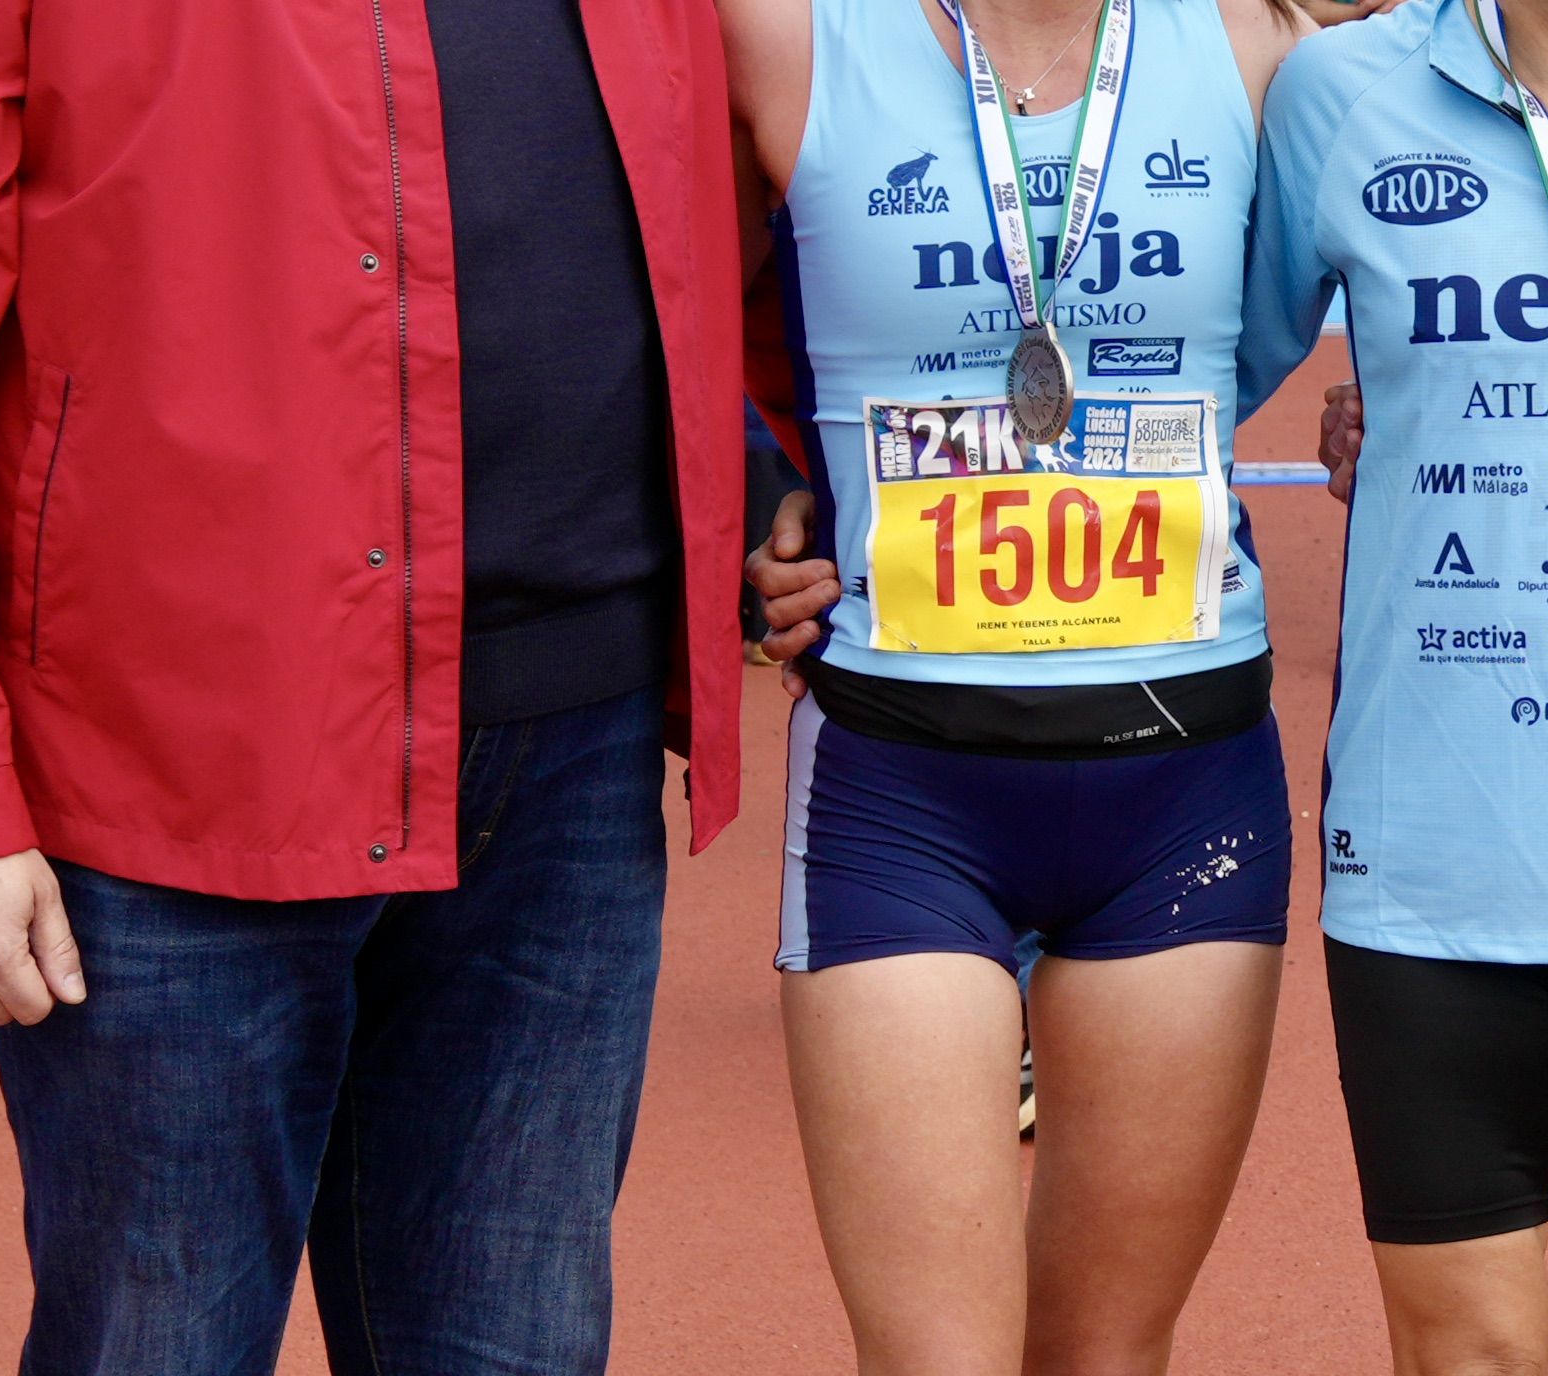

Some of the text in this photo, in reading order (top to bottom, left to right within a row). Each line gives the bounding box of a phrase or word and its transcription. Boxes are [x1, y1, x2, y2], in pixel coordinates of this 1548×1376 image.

[1096, 65, 1114, 93] 2026
[974, 79, 997, 105] XII
[1373, 152, 1472, 172] AGUACATE & MANGO
[868, 186, 950, 206] CUEVA
[1001, 182, 1019, 211] 2026
[1068, 163, 1099, 236] XII MEDIA
[1366, 167, 1482, 214] TROPS
[868, 201, 950, 216] DENERJA
[958, 302, 1146, 335] ATLTISMO
[1131, 338, 1178, 346] COMERCIAL
[961, 348, 1002, 359] metro
[1093, 343, 1179, 367] Rogelio
[1085, 406, 1115, 419] Ciudad
[1116, 407, 1127, 420] de
[1084, 417, 1127, 434] LUCENA
[1135, 417, 1189, 431] carreras
[912, 407, 1024, 475] 21K
[1134, 427, 1196, 445] populares
[879, 431, 897, 478] MEDIA
[967, 447, 979, 467] 097
[1082, 447, 1124, 471] 2026
[1473, 463, 1524, 477] metro
[1473, 479, 1529, 497] Málaga
[919, 488, 1165, 608] 1504
[1414, 577, 1500, 589] Junta de Andalucía
[976, 615, 1122, 630] IRENE YÉBENES ALCÁNTARA
[1022, 636, 1067, 646] TALLA S
[1452, 624, 1527, 650] activa
[1437, 656, 1452, 665] que
[1453, 654, 1526, 665] electrodomésticos
[1103, 725, 1161, 744] PULSE BELT
